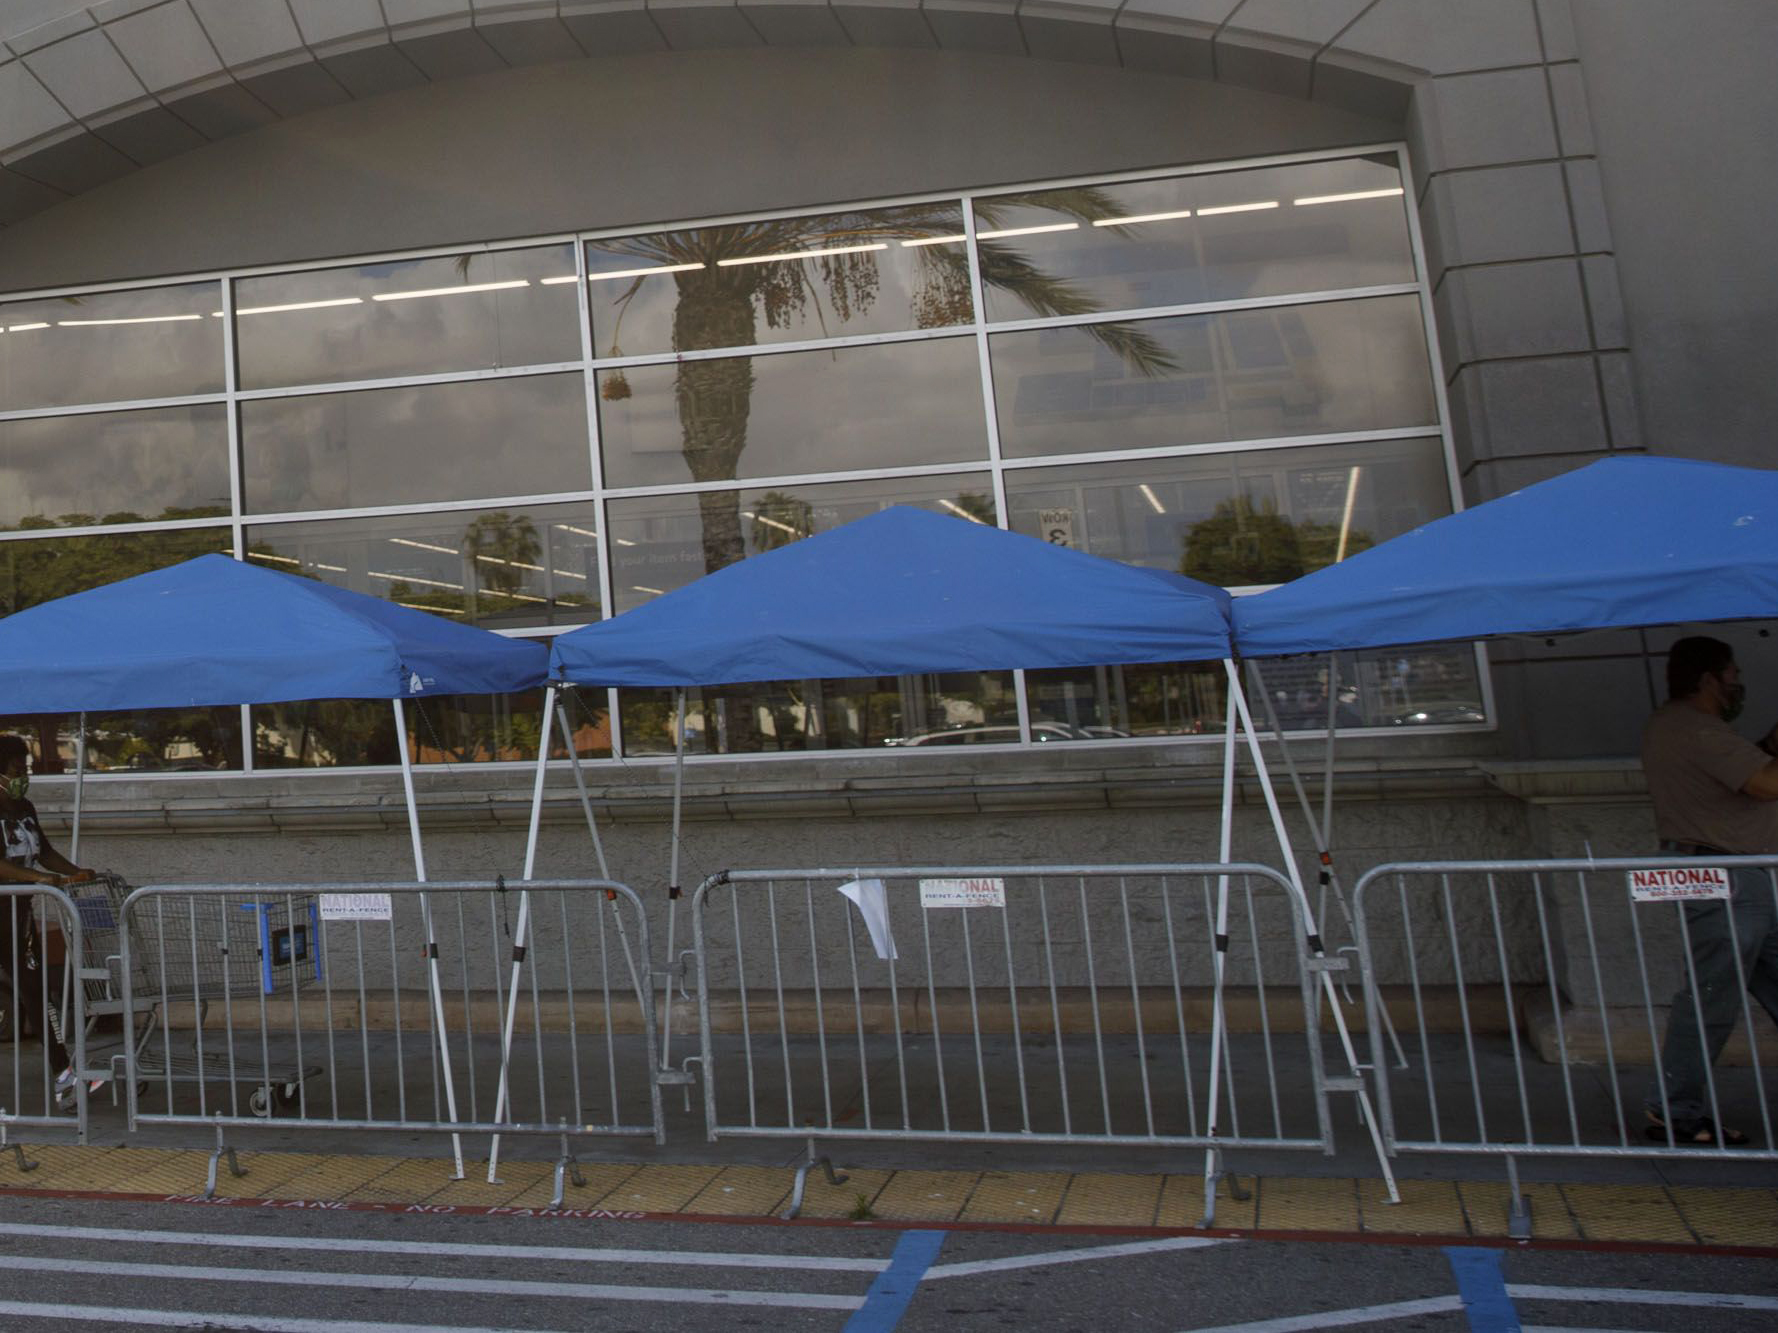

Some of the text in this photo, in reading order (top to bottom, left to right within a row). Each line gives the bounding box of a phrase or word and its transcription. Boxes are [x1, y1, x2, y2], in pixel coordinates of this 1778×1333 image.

[1633, 869, 1724, 886] NATIONAL
[322, 894, 388, 907] NATIONAL
[164, 1194, 234, 1205] FIRE
[261, 1199, 352, 1210] LANE
[405, 1204, 456, 1213] NO
[487, 1206, 646, 1219] PARKING
